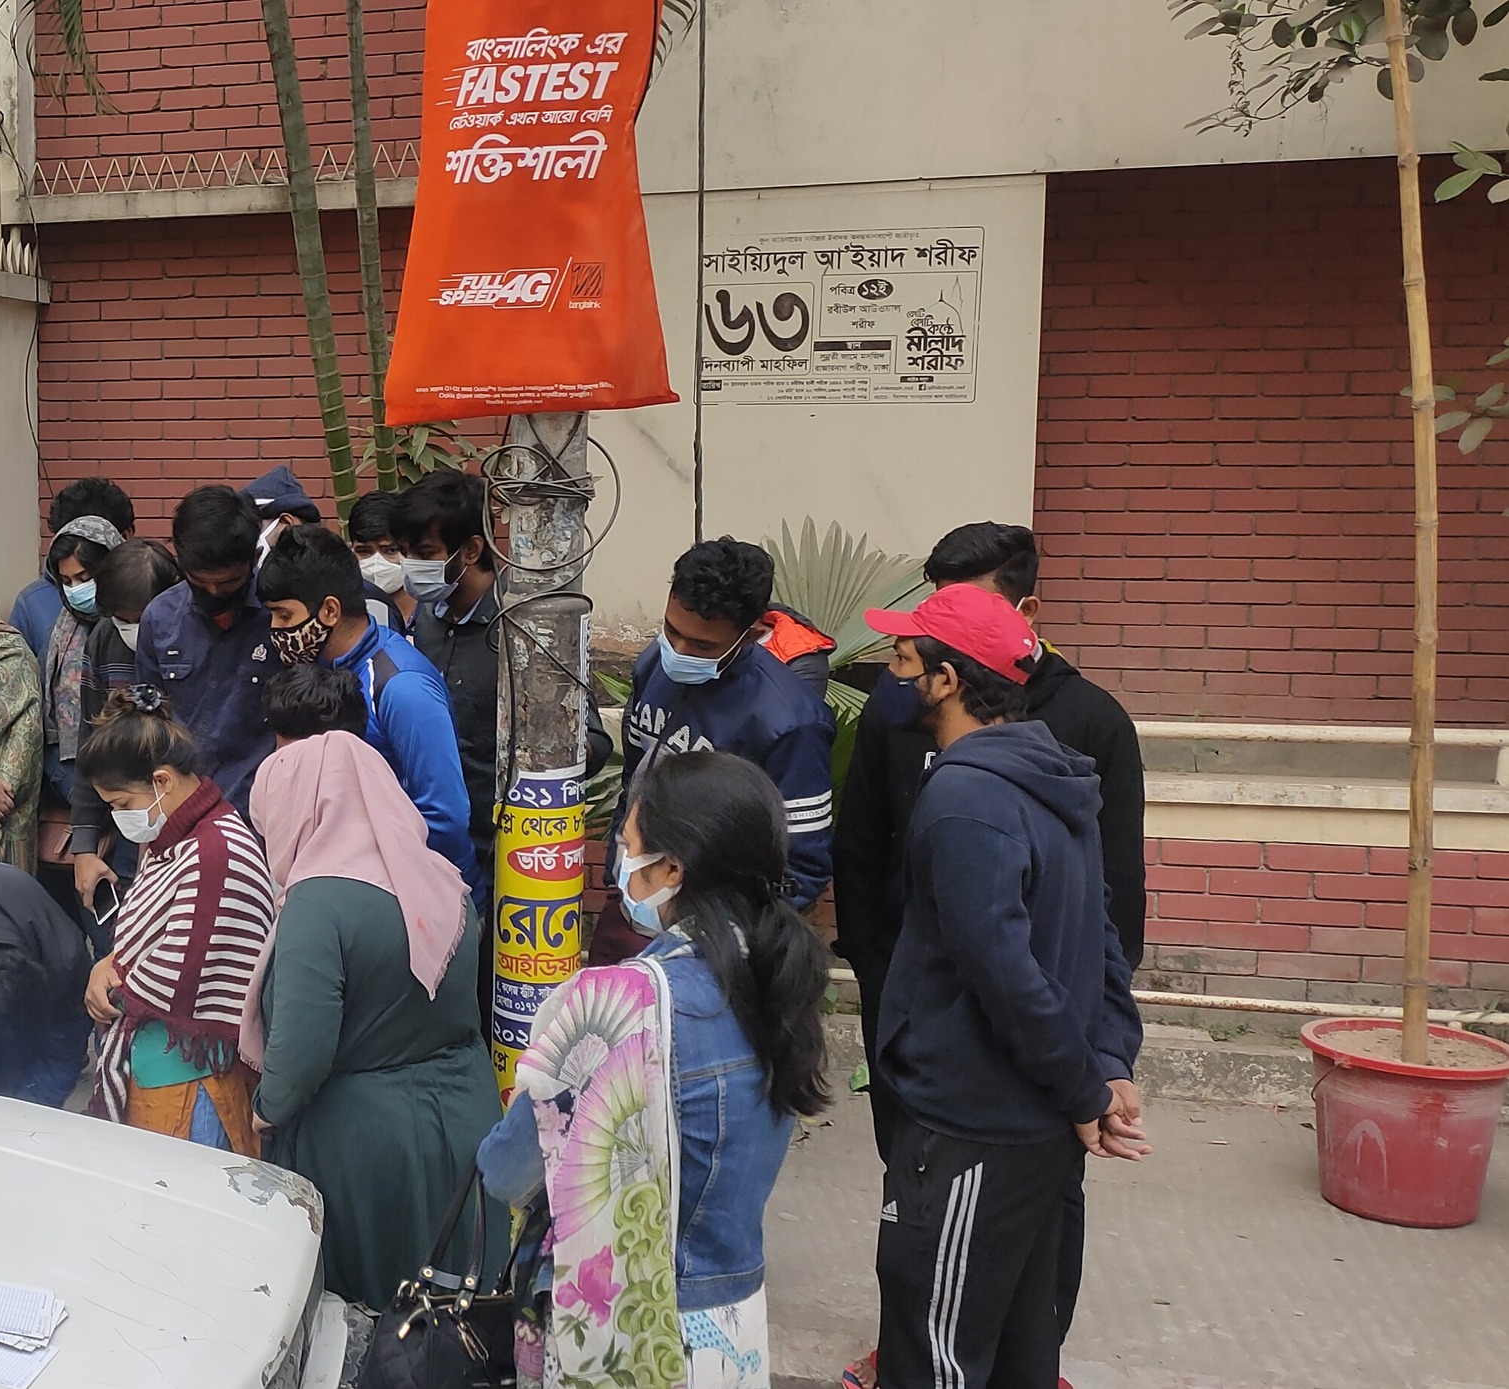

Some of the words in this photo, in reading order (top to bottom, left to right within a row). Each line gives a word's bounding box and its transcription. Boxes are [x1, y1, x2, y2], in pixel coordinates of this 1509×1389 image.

[466, 27, 584, 62] বাংলালিংক
[586, 31, 628, 55] এর
[455, 62, 620, 107] FASTEST
[505, 111, 538, 126] এখন
[541, 109, 579, 124] আরো
[580, 105, 613, 123] বেশি
[445, 130, 608, 184] শক্তিশালী
[914, 239, 981, 268] শরীফ
[438, 290, 500, 305] SPEED
[498, 272, 552, 304] 4G
[459, 275, 503, 290] FULL
[830, 283, 857, 296] পবিত্র
[705, 289, 810, 356] ৬৩
[850, 318, 876, 330] শরীফ
[760, 356, 809, 373] মাহফিল
[906, 347, 965, 372] শরীফ
[508, 787, 553, 808] ০২১
[521, 814, 569, 837] থেকে
[515, 846, 561, 873] ভর্তি
[494, 1020, 531, 1048] ২০২
